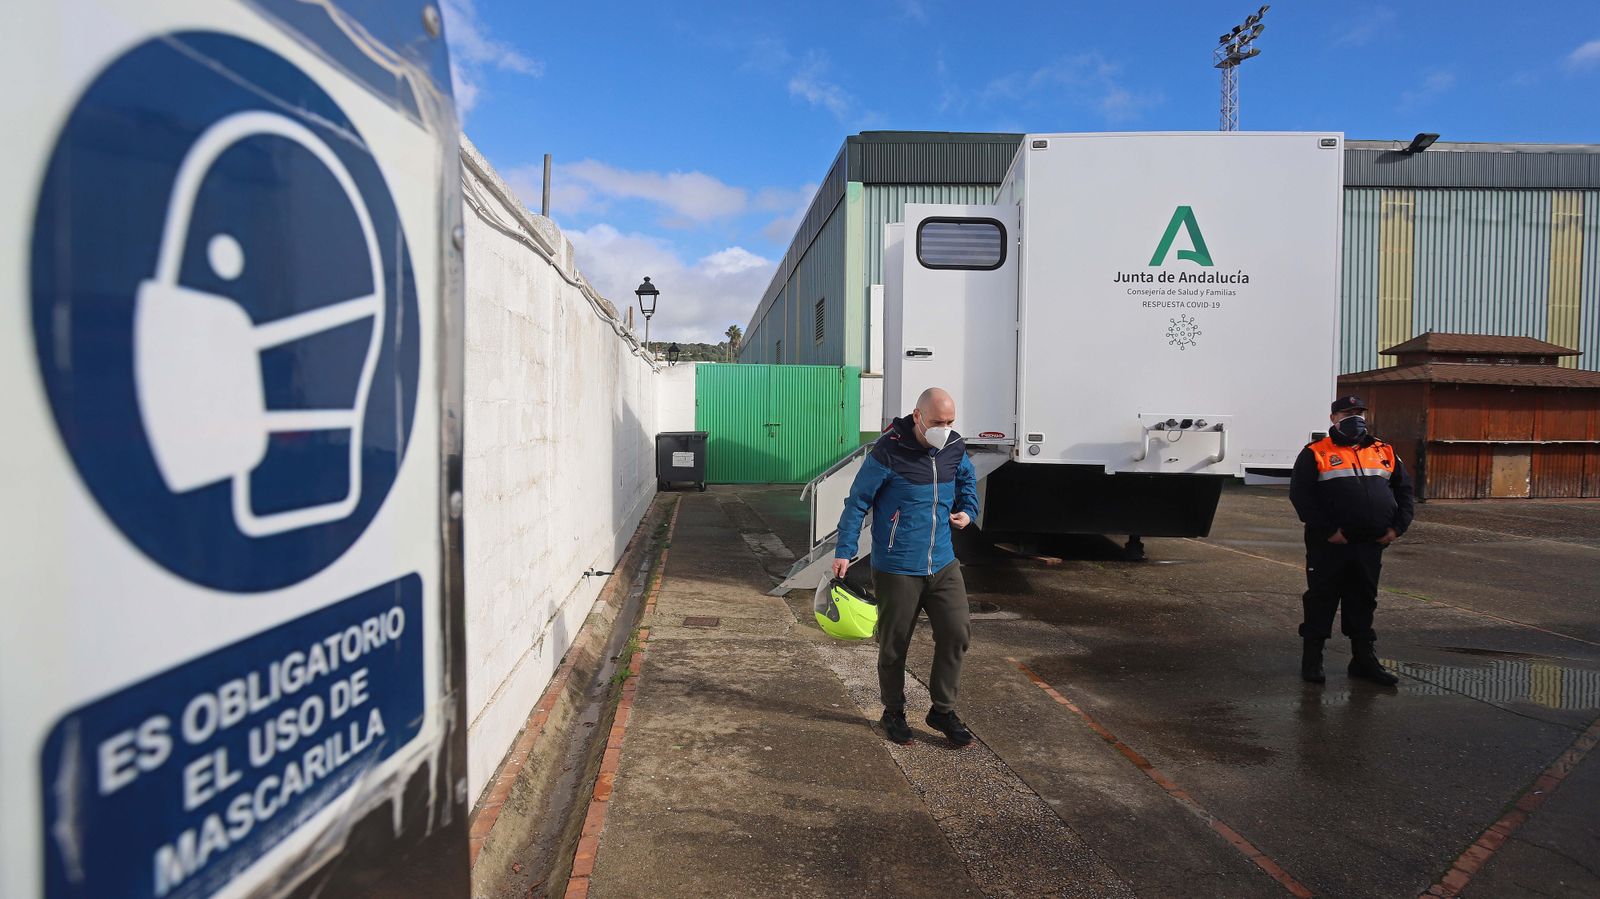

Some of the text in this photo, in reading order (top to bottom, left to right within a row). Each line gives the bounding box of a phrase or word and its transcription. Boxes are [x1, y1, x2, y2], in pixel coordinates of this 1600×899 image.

[1113, 270, 1249, 283] Junta de Andalucía
[1127, 288, 1166, 296] Consejería
[99, 606, 406, 796] ES OBLIGATORIO
[183, 667, 370, 811] EL USO DE
[154, 707, 386, 898] MASCARILLA
